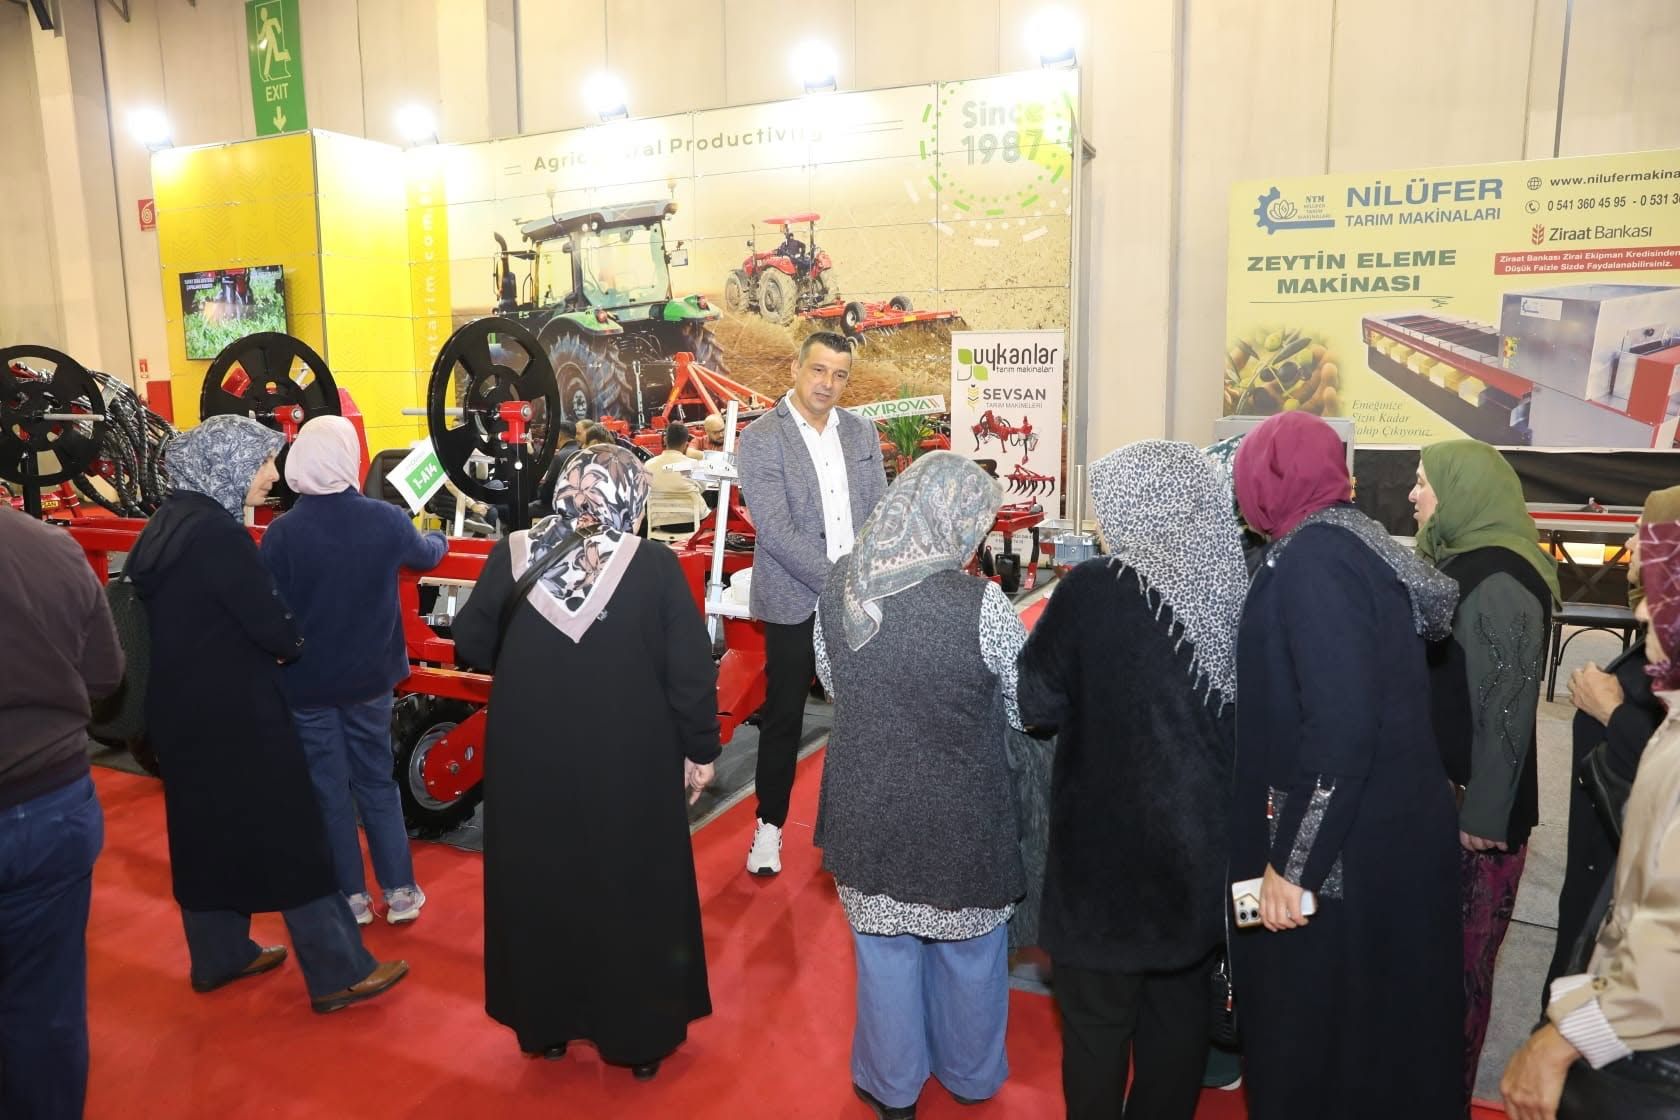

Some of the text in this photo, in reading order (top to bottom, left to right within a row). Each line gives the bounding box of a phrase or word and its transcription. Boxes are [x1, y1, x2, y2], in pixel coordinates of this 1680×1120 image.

[266, 83, 288, 102] EXIT
[961, 129, 1043, 166] 1987
[1550, 169, 1680, 187] www.nilufermakina
[1346, 178, 1503, 208] NİLÜFER
[1547, 200, 1554, 212] 0
[1556, 199, 1574, 211] 541
[1577, 198, 1596, 210] 360
[1598, 197, 1611, 209] 45
[1613, 196, 1627, 208] 95
[1640, 194, 1647, 207] 0
[1650, 193, 1669, 206] 531
[1345, 207, 1501, 228] TARIM MAKİNALARI
[1549, 225, 1653, 242] Ziraat Bankası
[1247, 249, 1457, 272] ZEYTİN ELEME
[1500, 254, 1525, 263] Ziraat
[1527, 253, 1560, 263] Bankası
[1585, 250, 1623, 262] Ekipman
[1626, 248, 1680, 259] Kredisinden
[1505, 259, 1673, 274] Düşük Faizle Sizde Faydalanabilirsiniz.
[1276, 273, 1421, 295] MAKİNASI
[983, 388, 1046, 401] SEVSAN
[1379, 413, 1410, 423] Kadar
[1354, 426, 1379, 438] ahip
